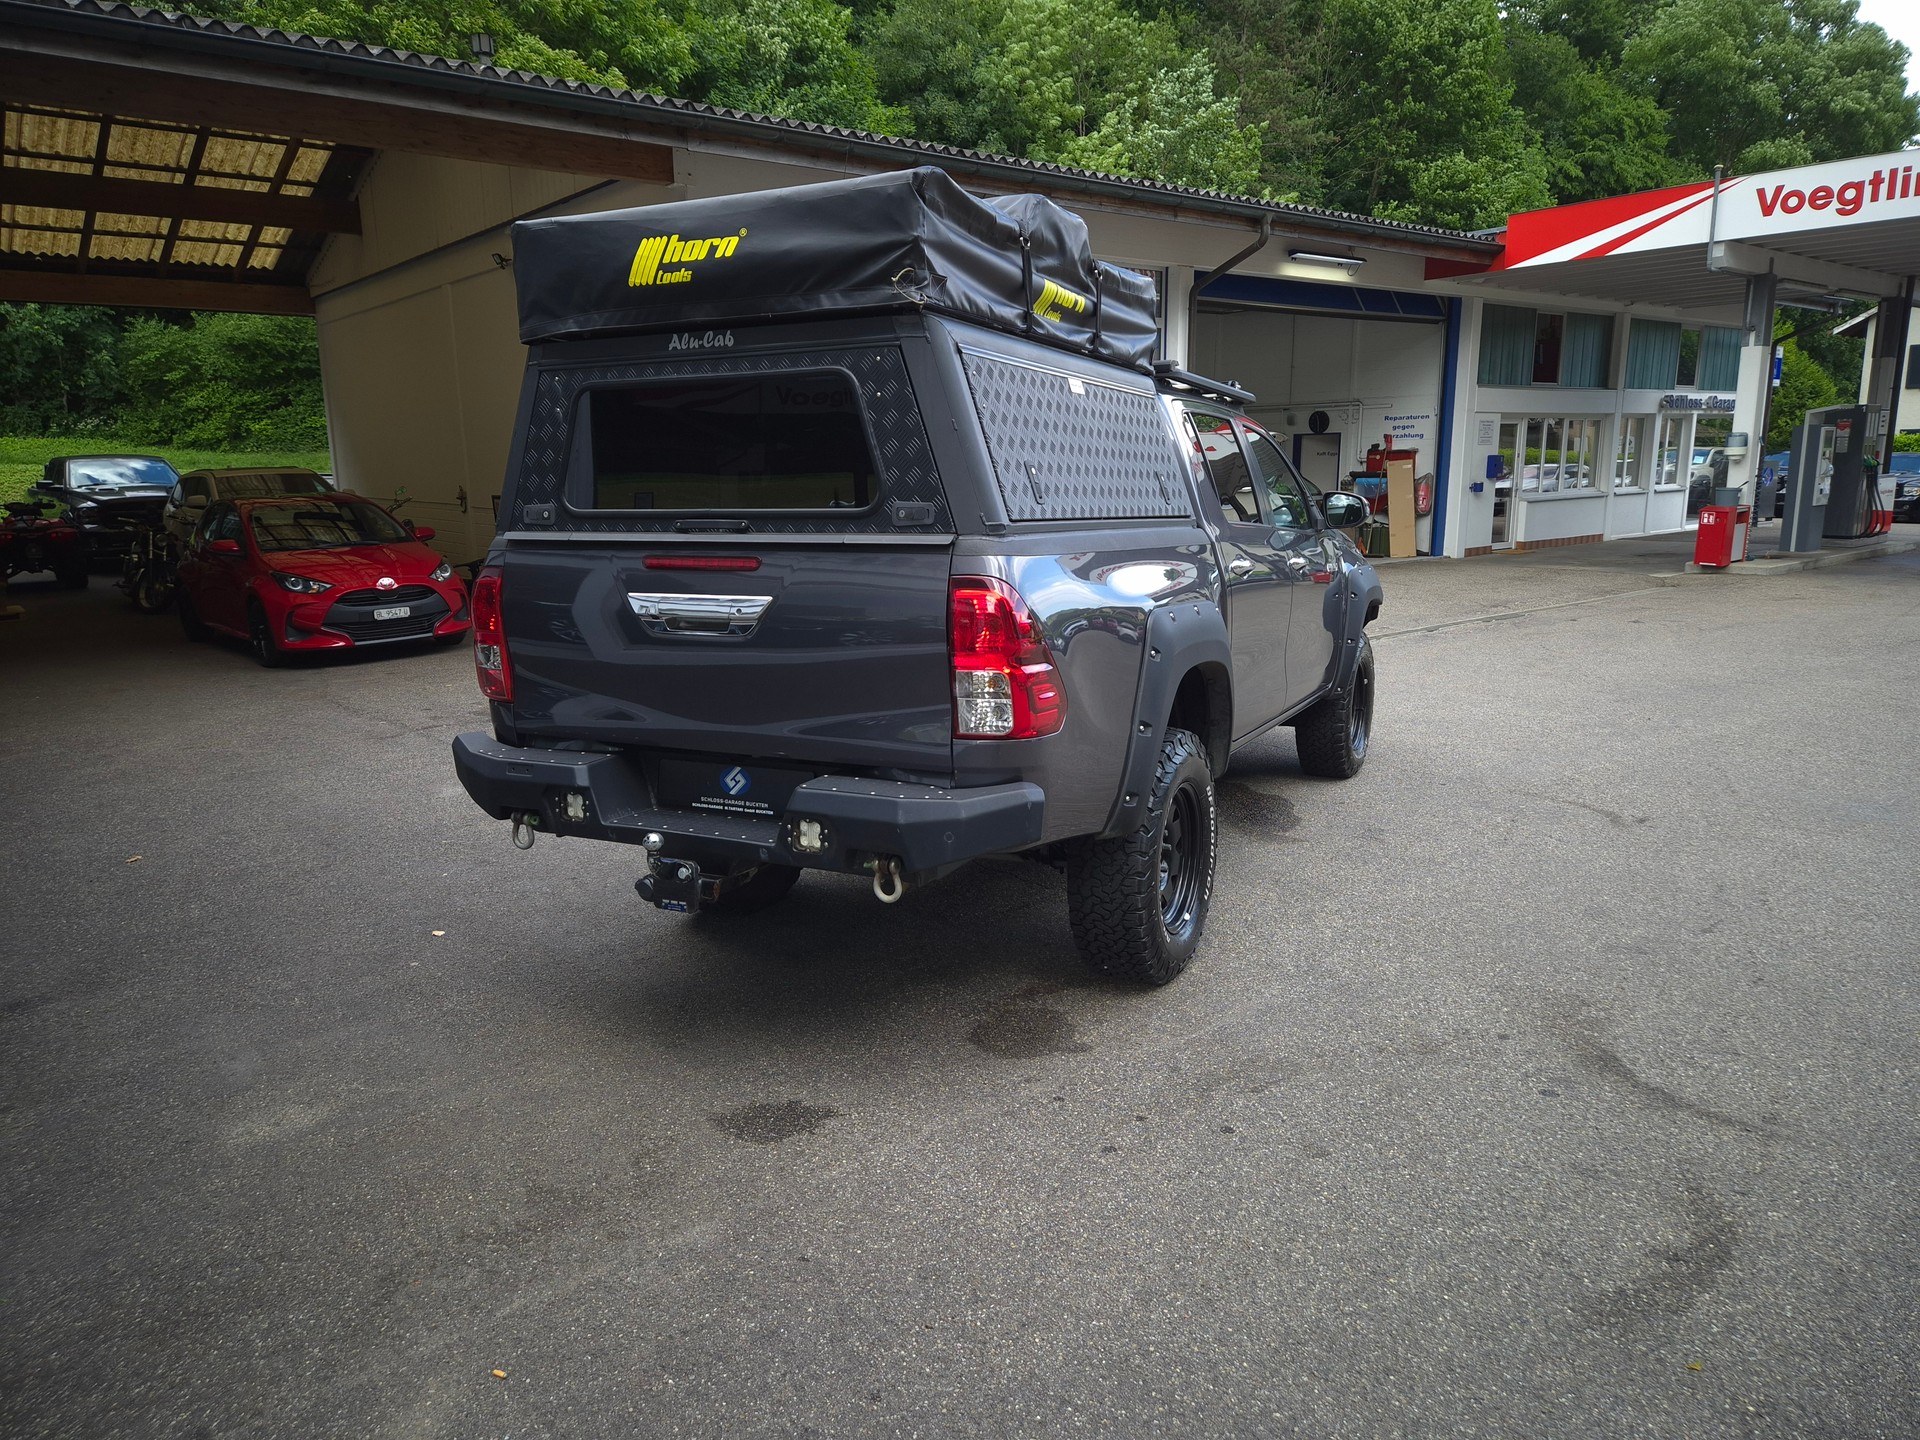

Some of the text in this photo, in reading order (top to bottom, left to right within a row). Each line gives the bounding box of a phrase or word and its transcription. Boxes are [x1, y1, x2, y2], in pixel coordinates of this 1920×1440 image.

[656, 267, 693, 285] tools
[1384, 414, 1430, 422] Reparaturen
[1392, 423, 1415, 431] gegen
[1386, 432, 1424, 440] rzahlung
